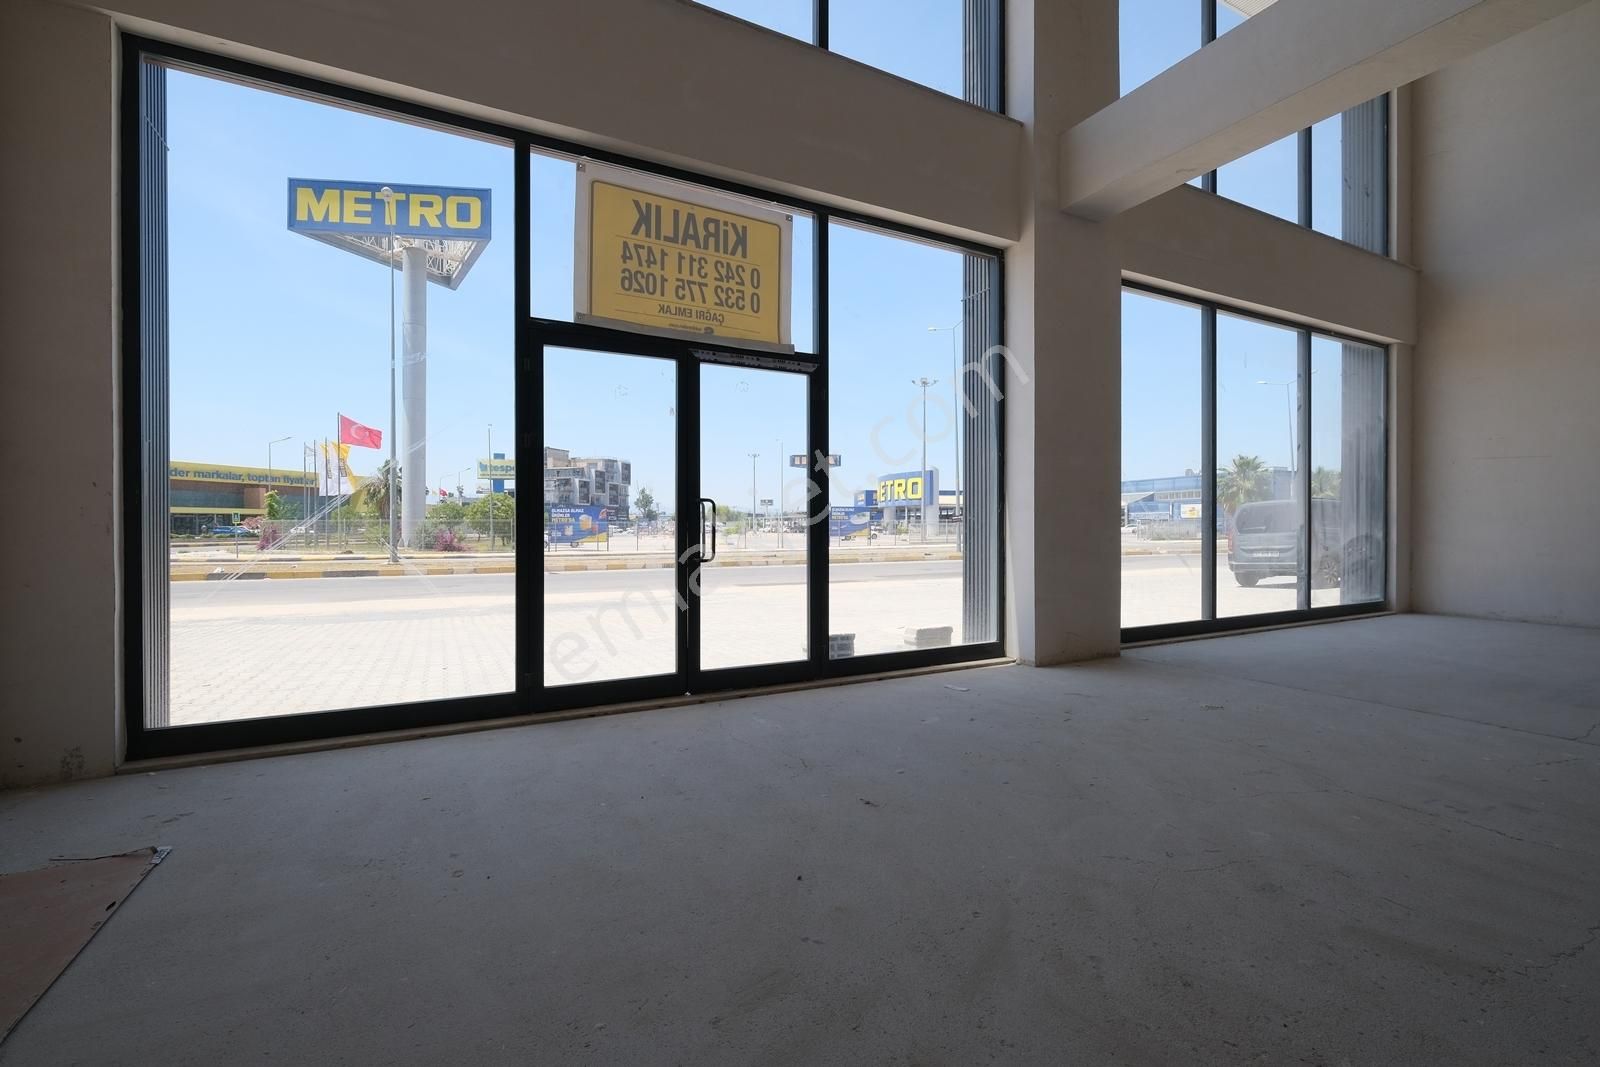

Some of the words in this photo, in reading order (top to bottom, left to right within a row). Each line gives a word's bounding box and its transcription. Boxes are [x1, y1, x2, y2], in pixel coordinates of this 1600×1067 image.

[296, 187, 482, 230] METRO
[283, 475, 316, 486] fiyatar
[877, 477, 922, 502] ETRO
